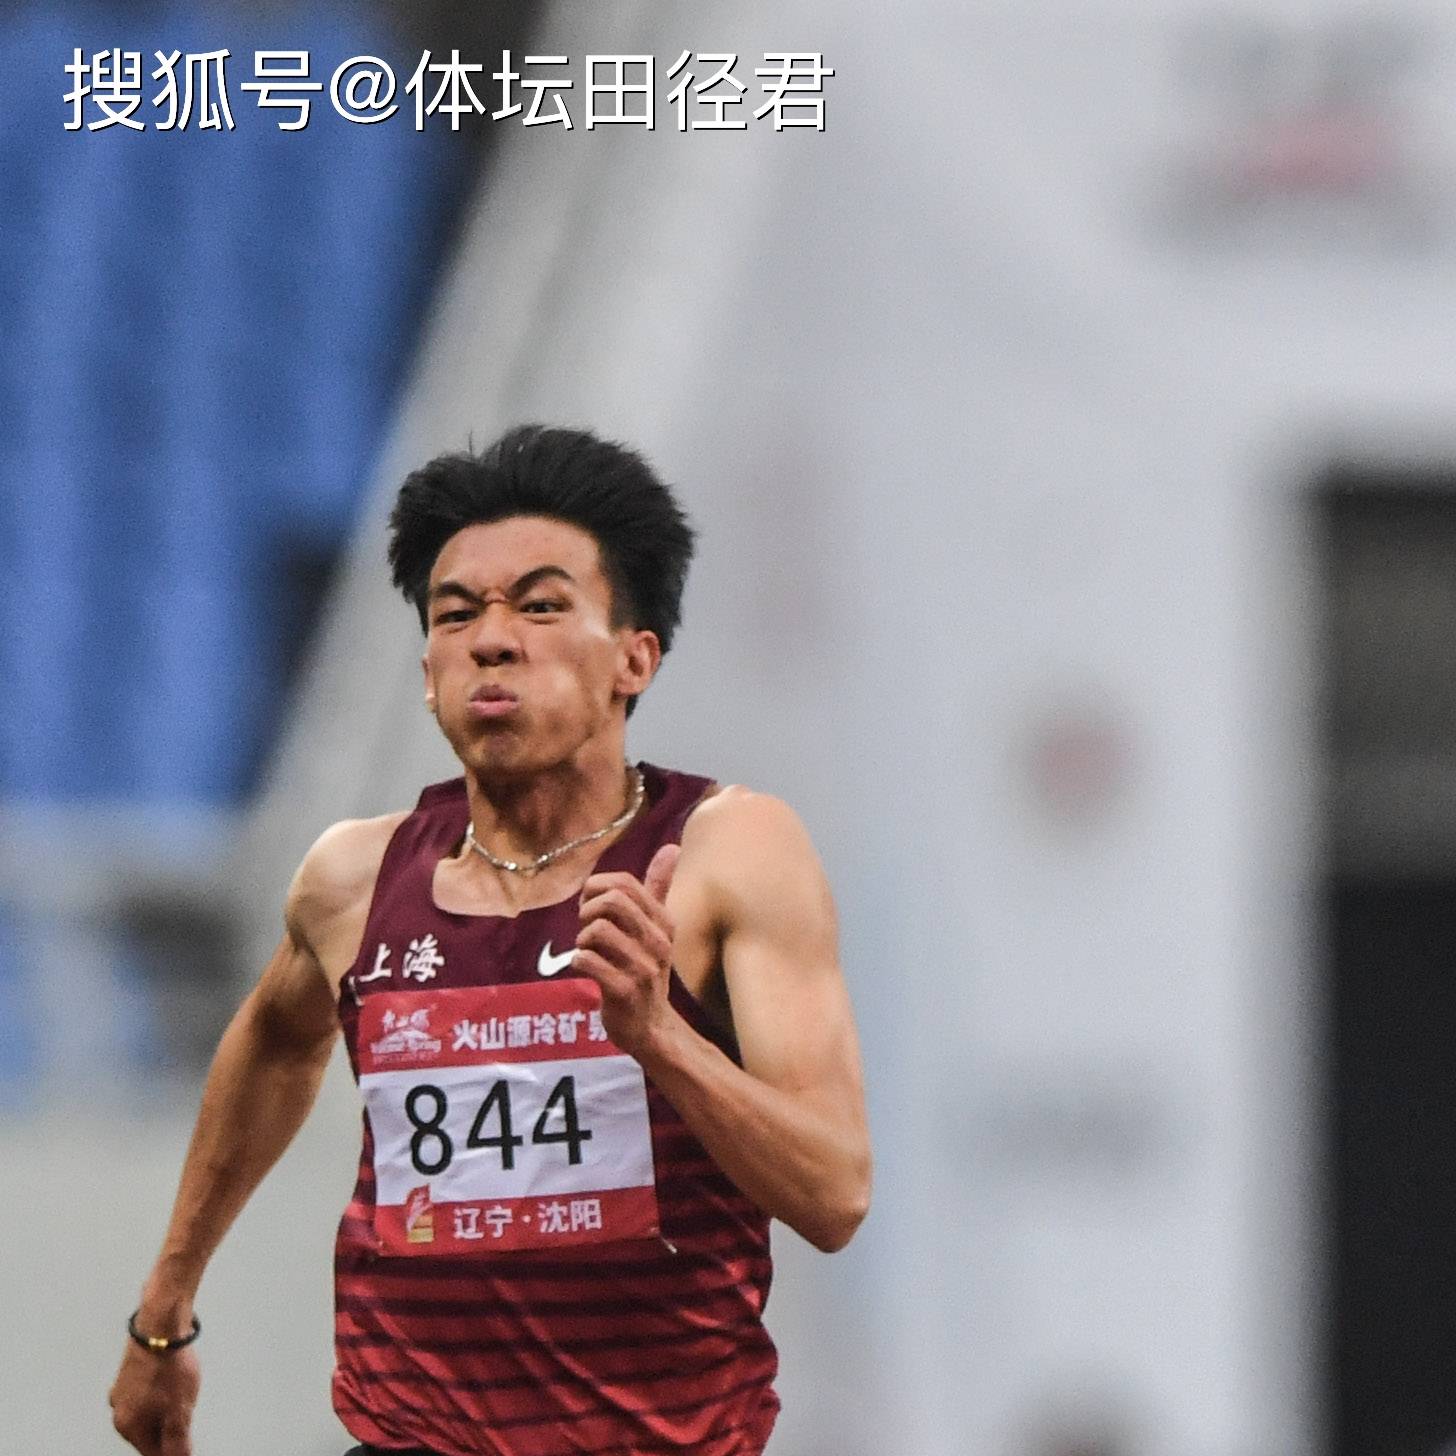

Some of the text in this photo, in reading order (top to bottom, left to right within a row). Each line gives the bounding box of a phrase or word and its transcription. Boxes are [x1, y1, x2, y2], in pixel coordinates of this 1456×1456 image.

[360, 934, 445, 982] 上海
[404, 1074, 593, 1177] 844
[453, 1198, 602, 1240] 辽宁·沈阳
